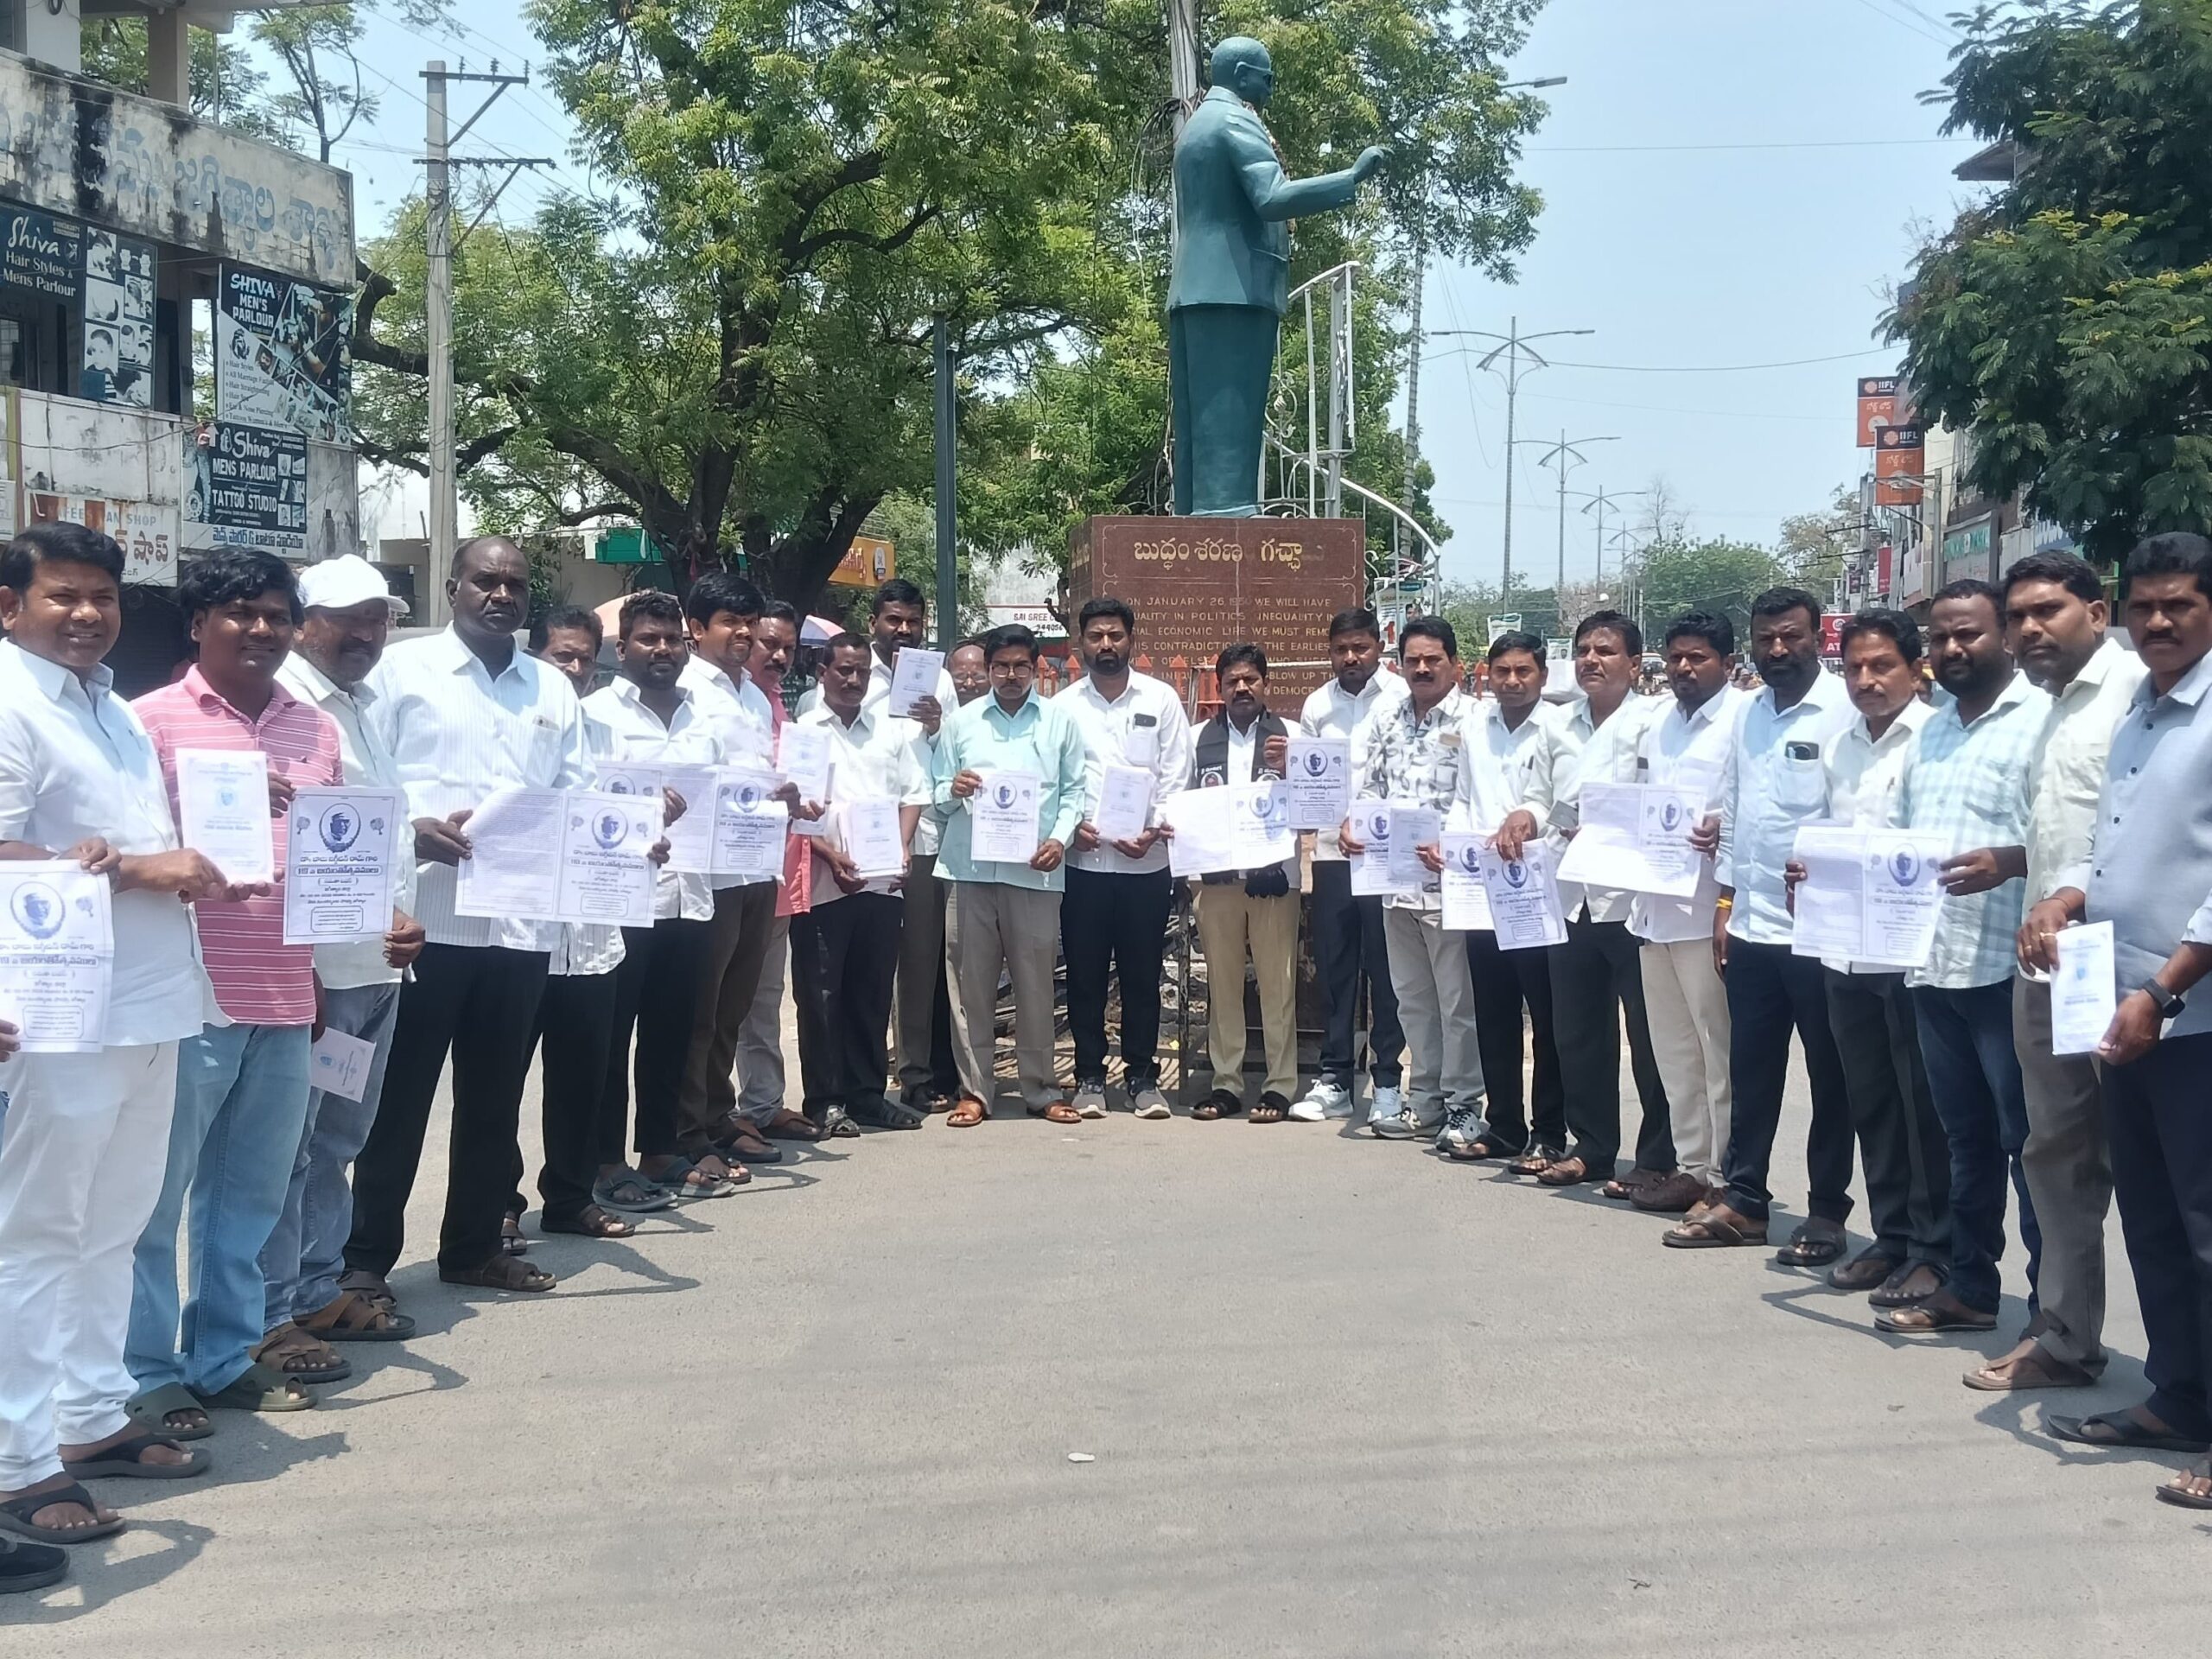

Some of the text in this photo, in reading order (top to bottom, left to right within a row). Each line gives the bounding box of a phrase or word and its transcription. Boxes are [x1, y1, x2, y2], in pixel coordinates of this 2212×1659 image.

[8, 217, 60, 257] Shiva
[6, 251, 30, 268] Hair
[33, 257, 65, 277] Styles
[3, 268, 76, 297] Mens Parlour
[230, 273, 276, 299] SHIVA
[239, 293, 268, 312] MEN'S
[232, 306, 274, 327] PARLOUR
[232, 431, 270, 458] Shiva
[213, 458, 276, 481] MENS PARLOUR
[212, 489, 245, 509] TATTOO
[248, 494, 277, 512] STUDIO
[106, 512, 119, 524] AN
[127, 514, 156, 526] SHOP
[1194, 537, 1243, 562] శరణ
[1261, 537, 1320, 572] గచ్ఛా
[1127, 597, 1141, 606] ON
[1147, 597, 1205, 606] JANUARY
[1210, 597, 1224, 606] 26
[1255, 598, 1270, 607] WE
[1276, 598, 1299, 607] WILL
[1304, 598, 1332, 607] HAVE
[1014, 613, 1026, 621] SAI
[1028, 613, 1048, 621] SREE
[1134, 612, 1167, 620] UALITY
[1174, 612, 1184, 620] IN
[1192, 612, 1245, 620] POLITICS
[1258, 612, 1323, 621] INEQUALITY
[1133, 626, 1153, 635] CIAL
[1158, 626, 1213, 635] ECONOMIC
[1251, 627, 1268, 636] WE
[1272, 627, 1300, 636] MUST
[1306, 627, 1330, 636] REMO
[1135, 642, 1148, 651] HIS
[1154, 642, 1236, 651] CONTRADICTIO
[1291, 642, 1330, 651] EARLIES
[1826, 643, 1840, 652] AT
[1269, 671, 1297, 680] BLOW
[1302, 671, 1316, 680] UP
[1273, 686, 1314, 695] DEMOC
